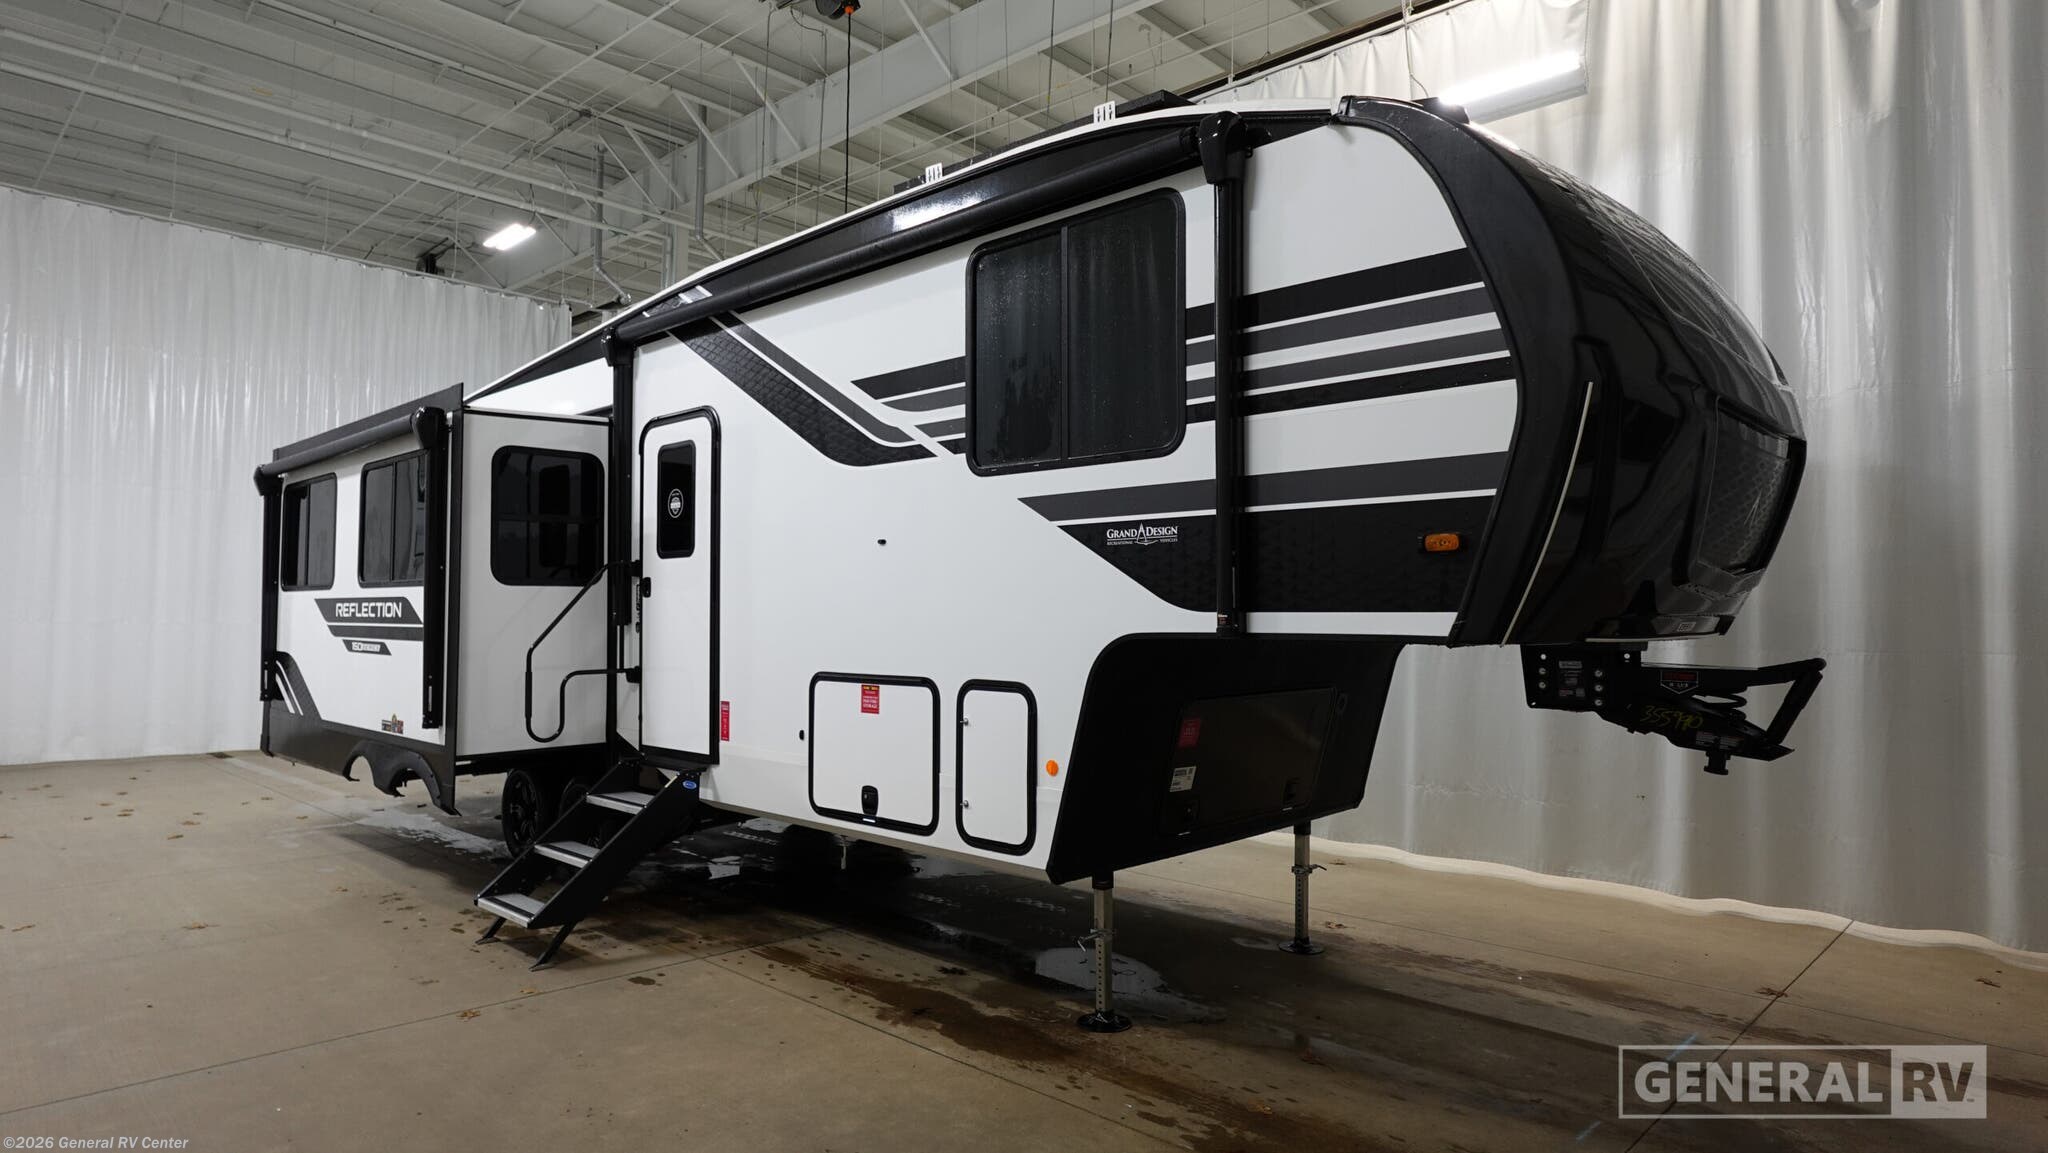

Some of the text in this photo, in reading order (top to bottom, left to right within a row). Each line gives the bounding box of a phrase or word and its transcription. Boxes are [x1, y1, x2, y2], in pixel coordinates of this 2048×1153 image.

[1106, 526, 1178, 539] GRAND DESIGN
[335, 602, 402, 618] REFLECTION
